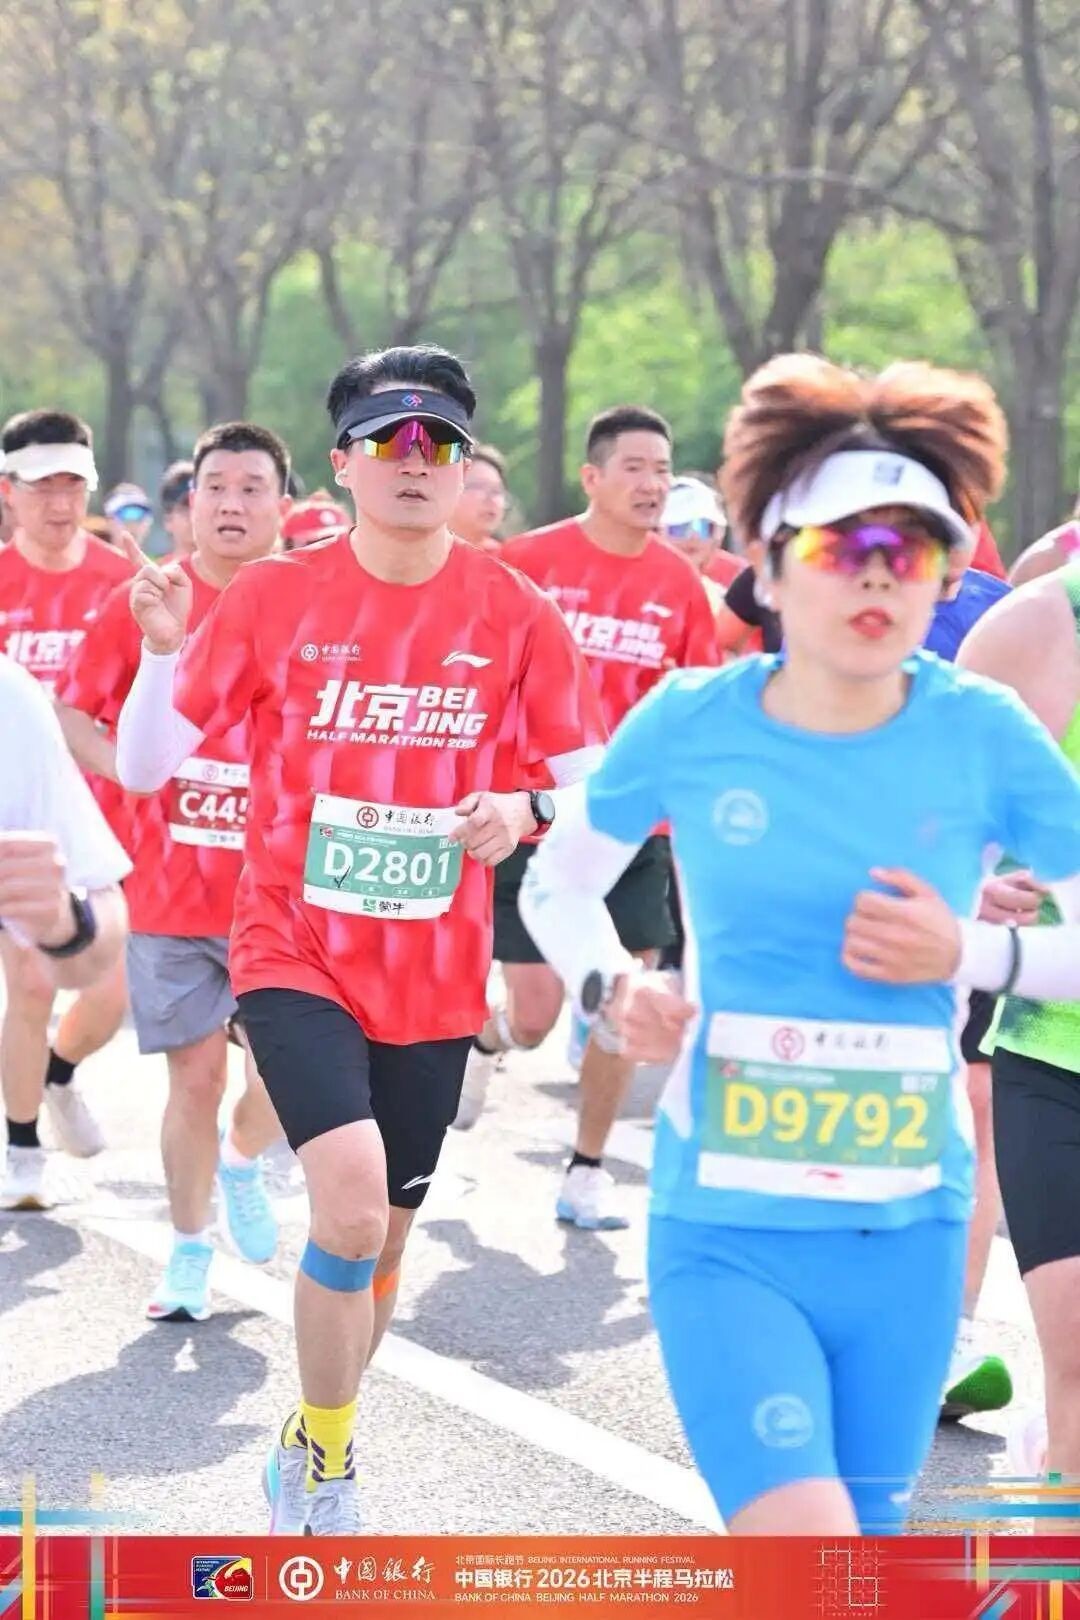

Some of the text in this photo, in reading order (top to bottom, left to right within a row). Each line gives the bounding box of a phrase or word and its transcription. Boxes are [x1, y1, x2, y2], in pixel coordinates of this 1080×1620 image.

[309, 680, 419, 731] 北京
[417, 686, 478, 710] BEI
[307, 729, 349, 742] HALF
[350, 732, 445, 748] MARATHON
[408, 711, 488, 736] JING
[323, 842, 450, 886] D2801
[723, 1082, 929, 1149] D9792
